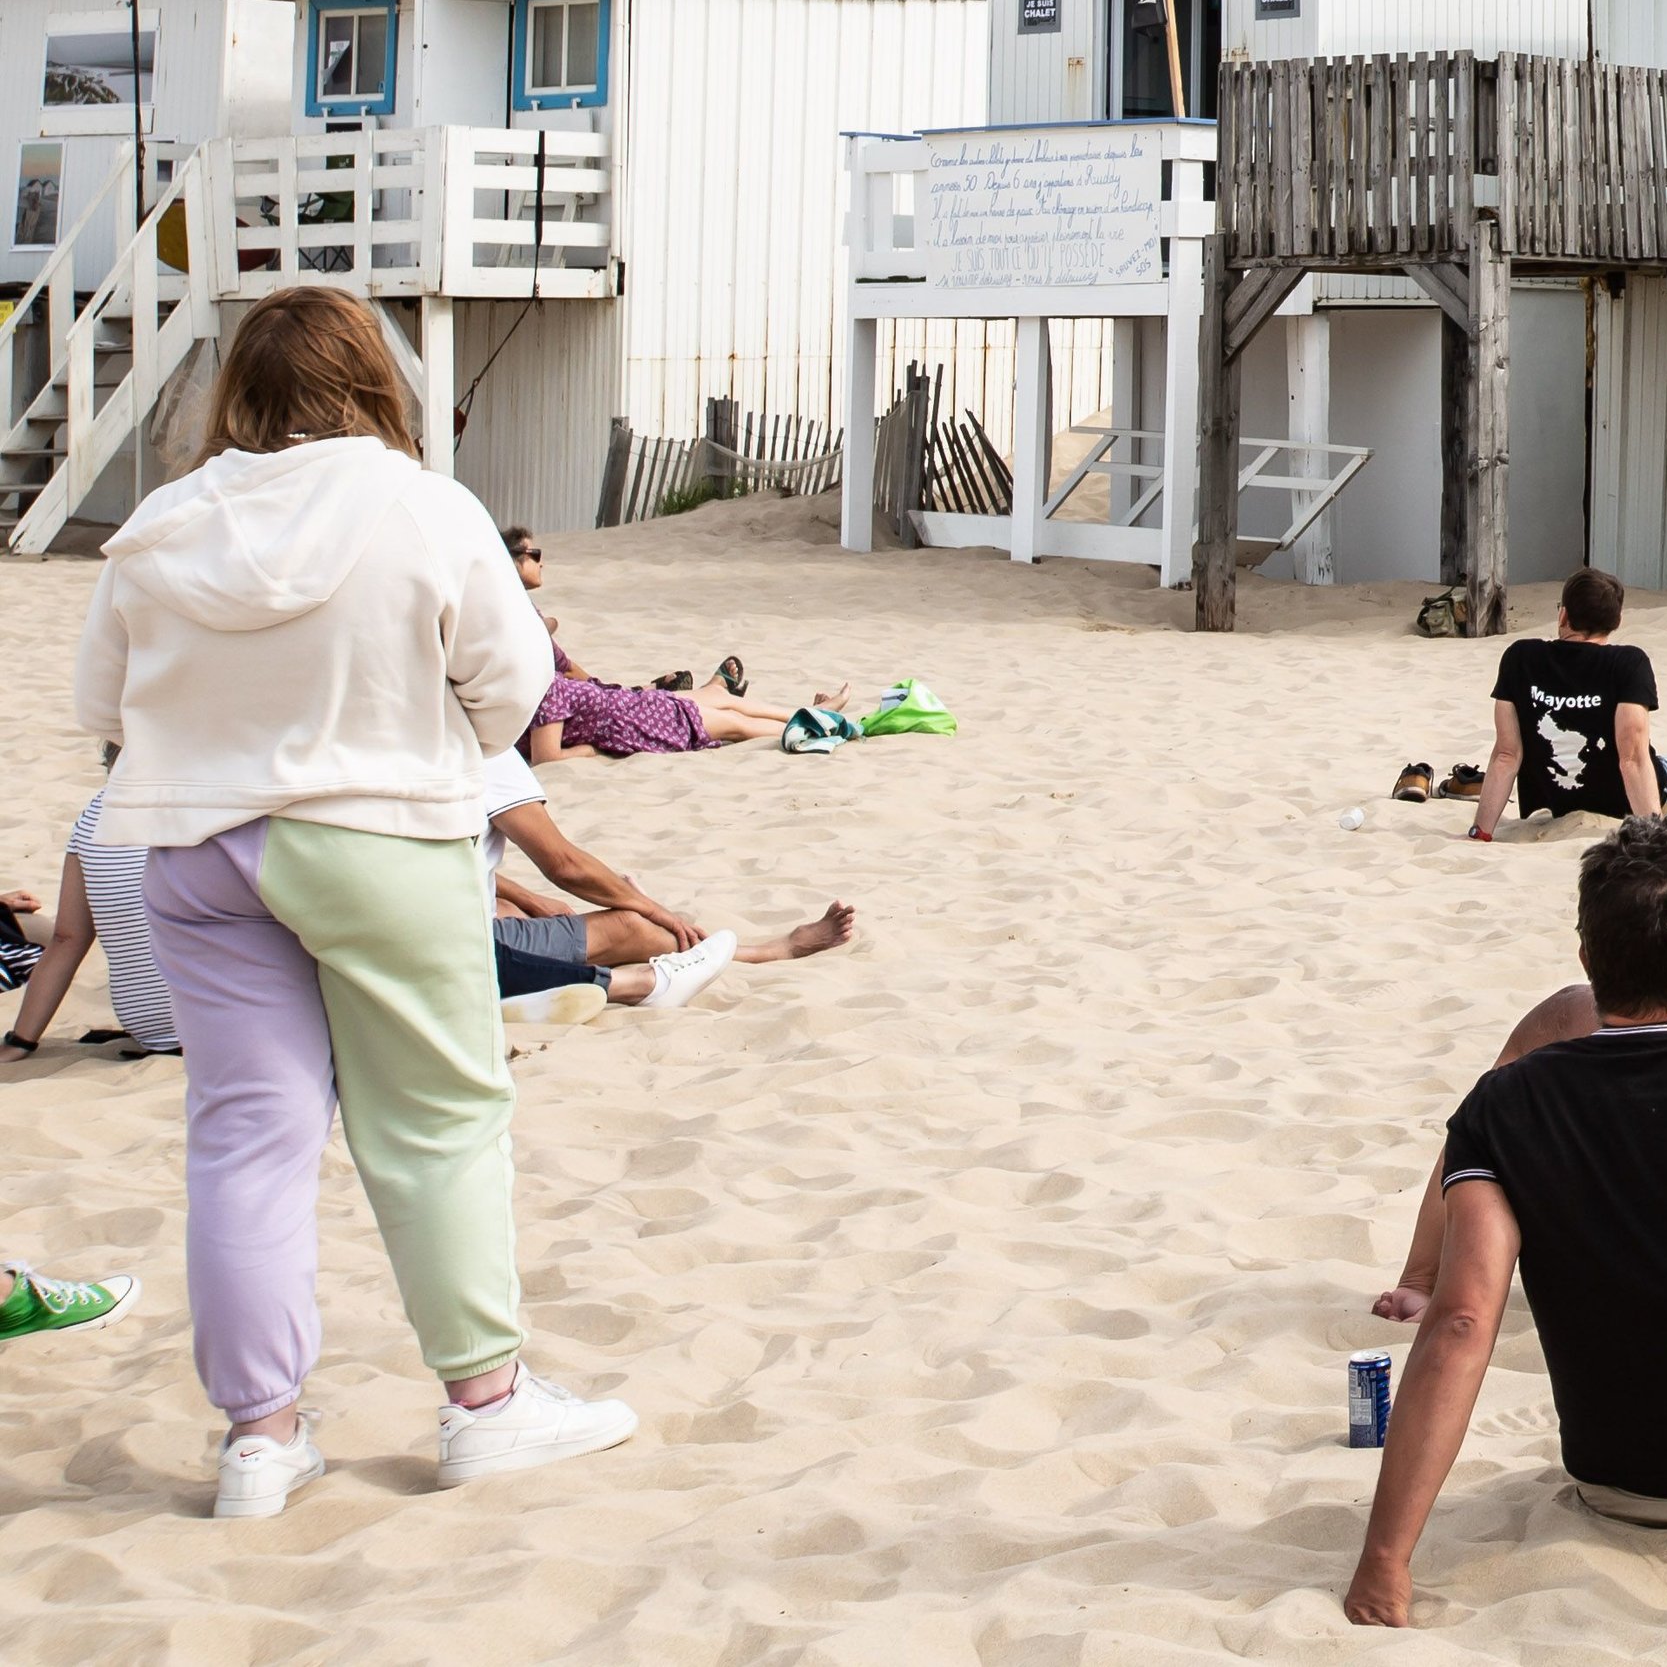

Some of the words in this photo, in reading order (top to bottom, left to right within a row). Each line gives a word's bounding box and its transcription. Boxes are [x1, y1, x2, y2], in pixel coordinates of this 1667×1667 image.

[1026, 0, 1036, 8] JE
[1037, 0, 1054, 7] SUIS
[1024, 8, 1056, 18] CHALET
[1530, 685, 1602, 712] Mayotte
